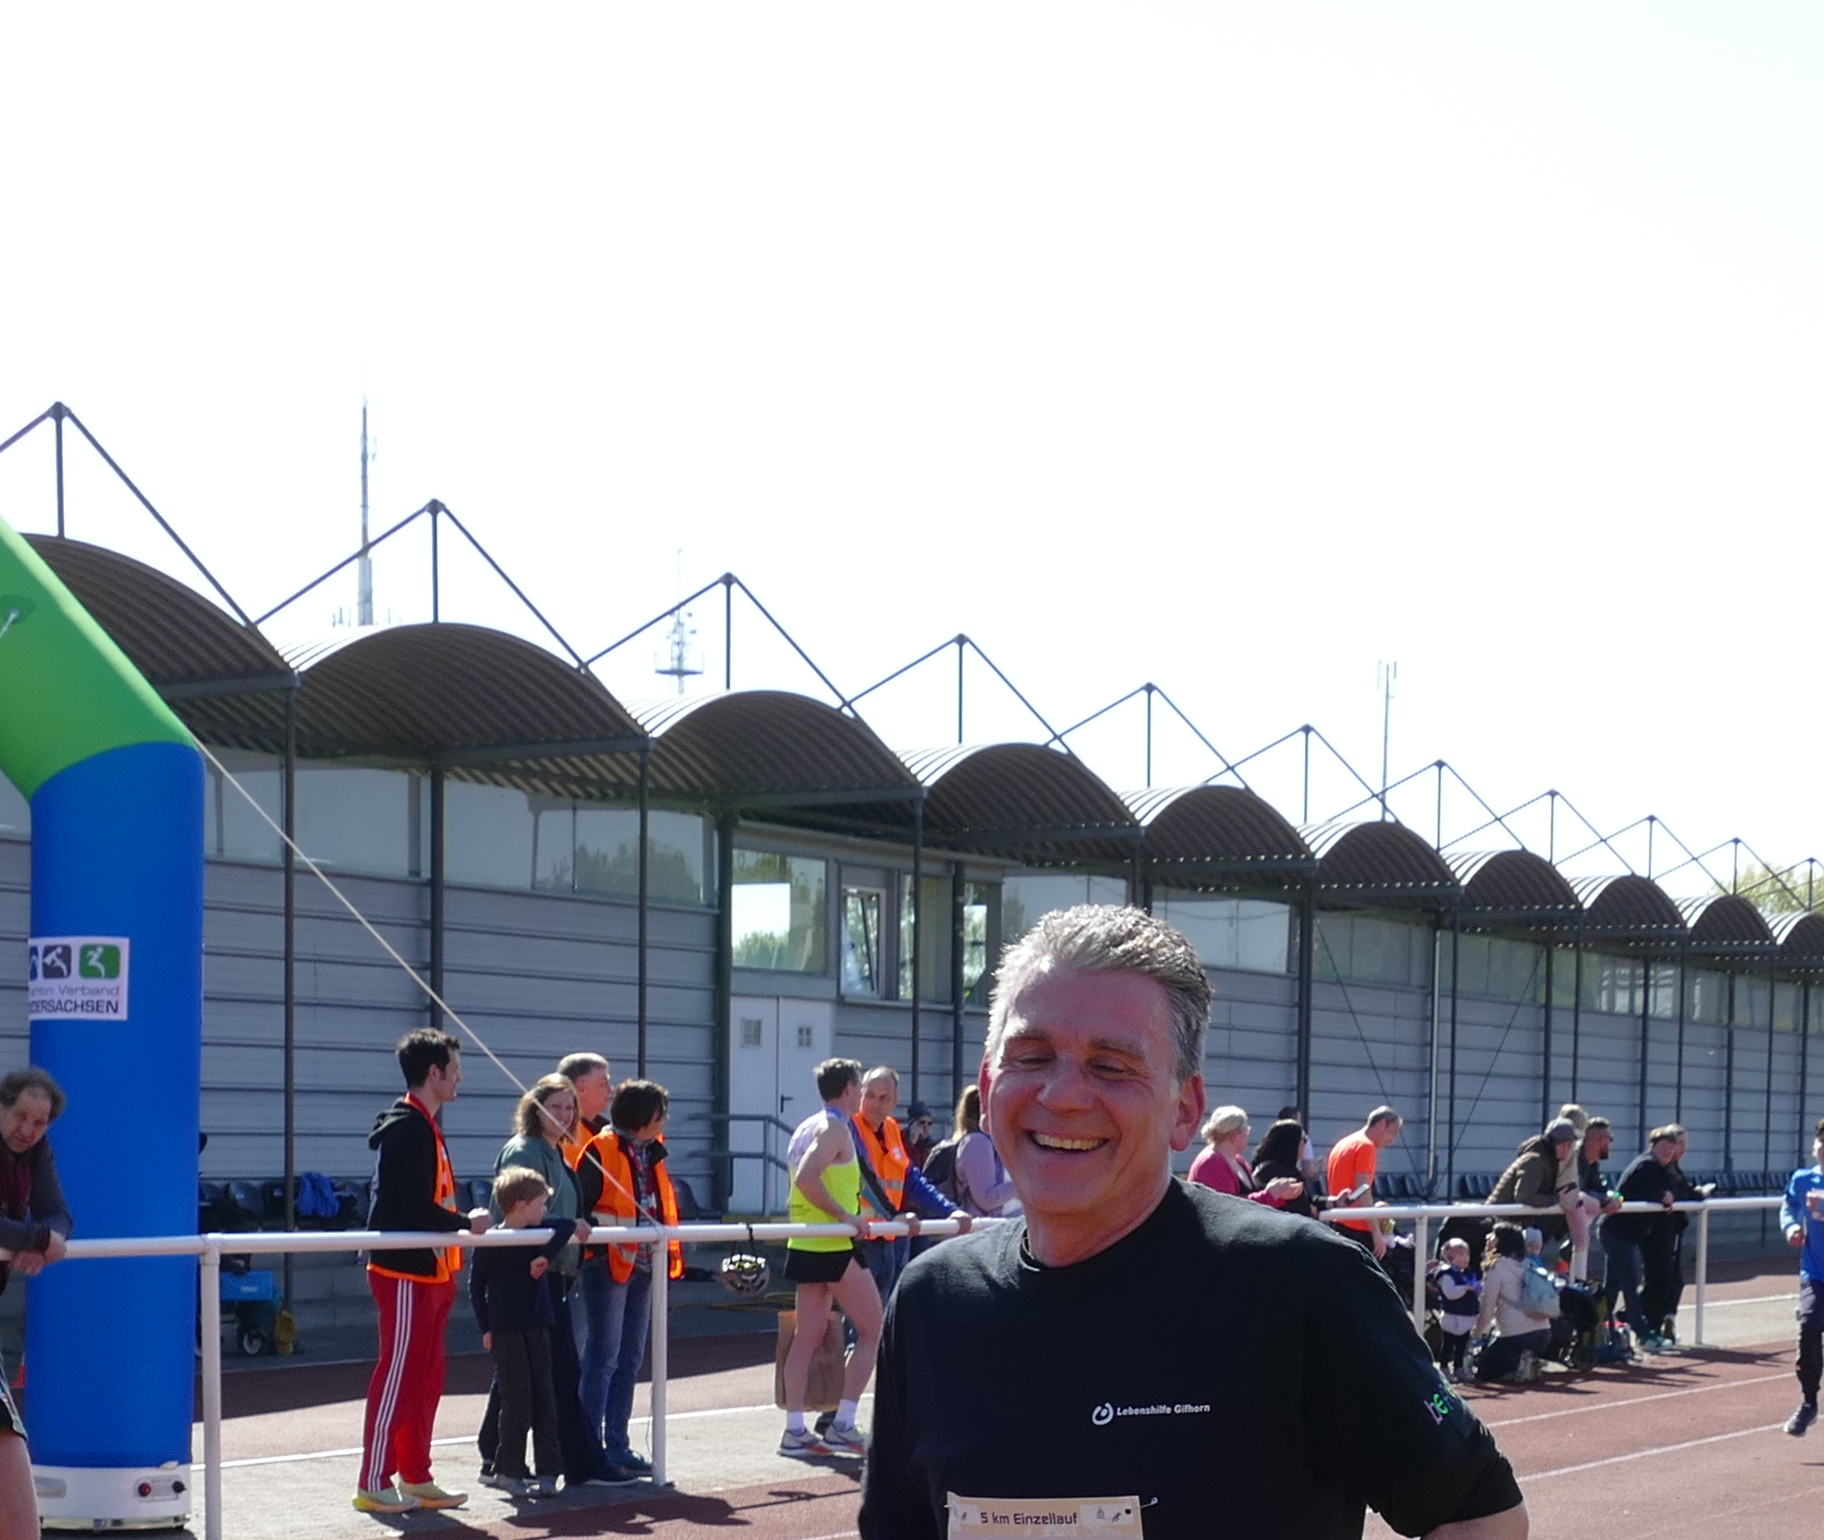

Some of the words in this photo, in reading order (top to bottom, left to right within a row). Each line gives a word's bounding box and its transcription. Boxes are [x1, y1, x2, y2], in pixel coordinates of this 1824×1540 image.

[1116, 1405, 1172, 1416] Lebenshilfe
[1173, 1404, 1211, 1414] Gifhorn
[980, 1512, 988, 1524] 5
[992, 1512, 1010, 1525] km
[1014, 1512, 1078, 1526] Einzellauf
